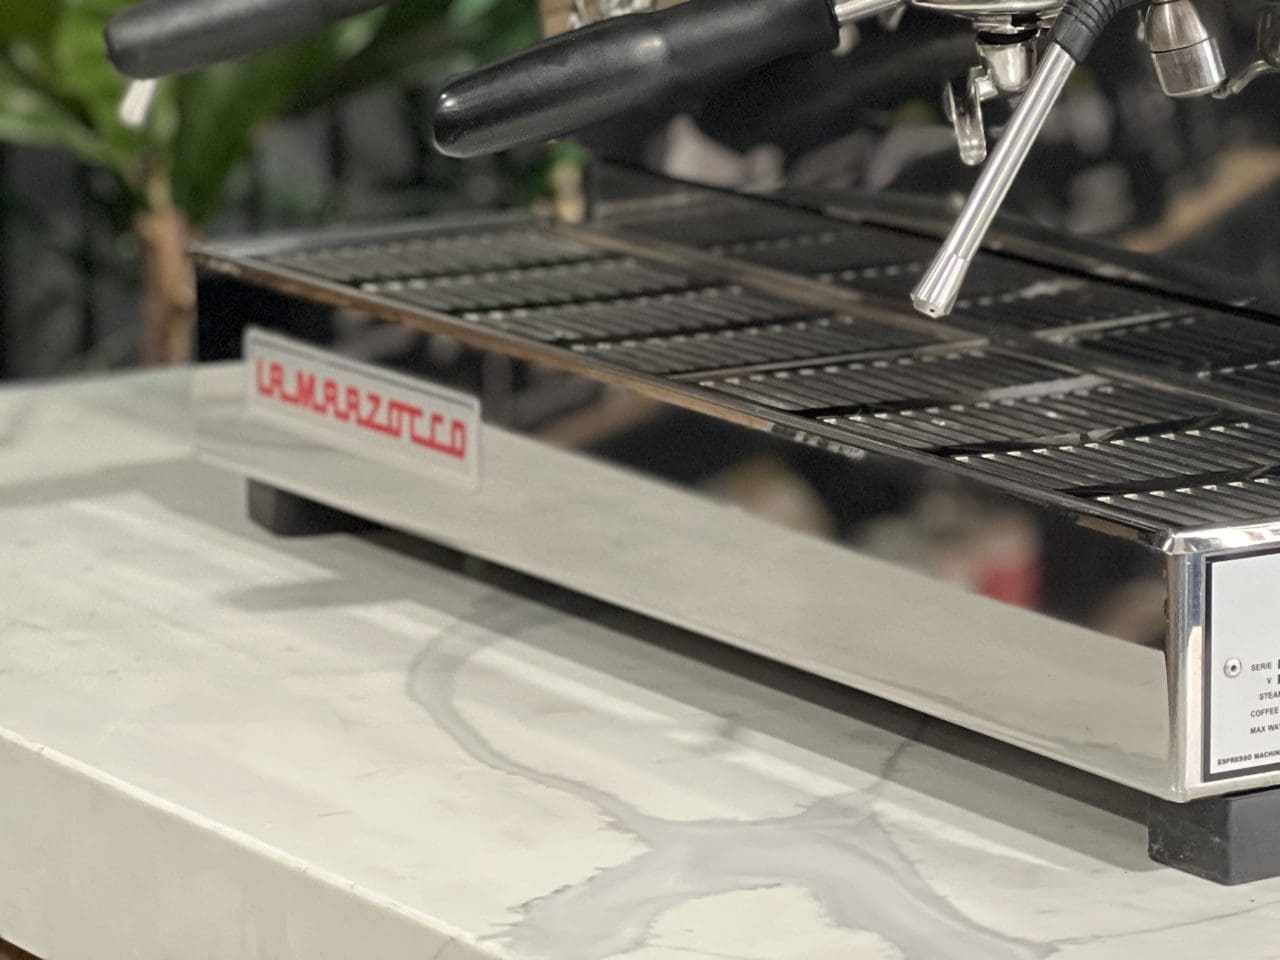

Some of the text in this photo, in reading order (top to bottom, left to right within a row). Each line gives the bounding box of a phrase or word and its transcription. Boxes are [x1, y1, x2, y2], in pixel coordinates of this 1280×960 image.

[1250, 661, 1273, 672] SERIE
[1250, 707, 1279, 718] COFFEE
[1250, 726, 1266, 734] MAX
[1217, 753, 1253, 765] ESPRESSO
